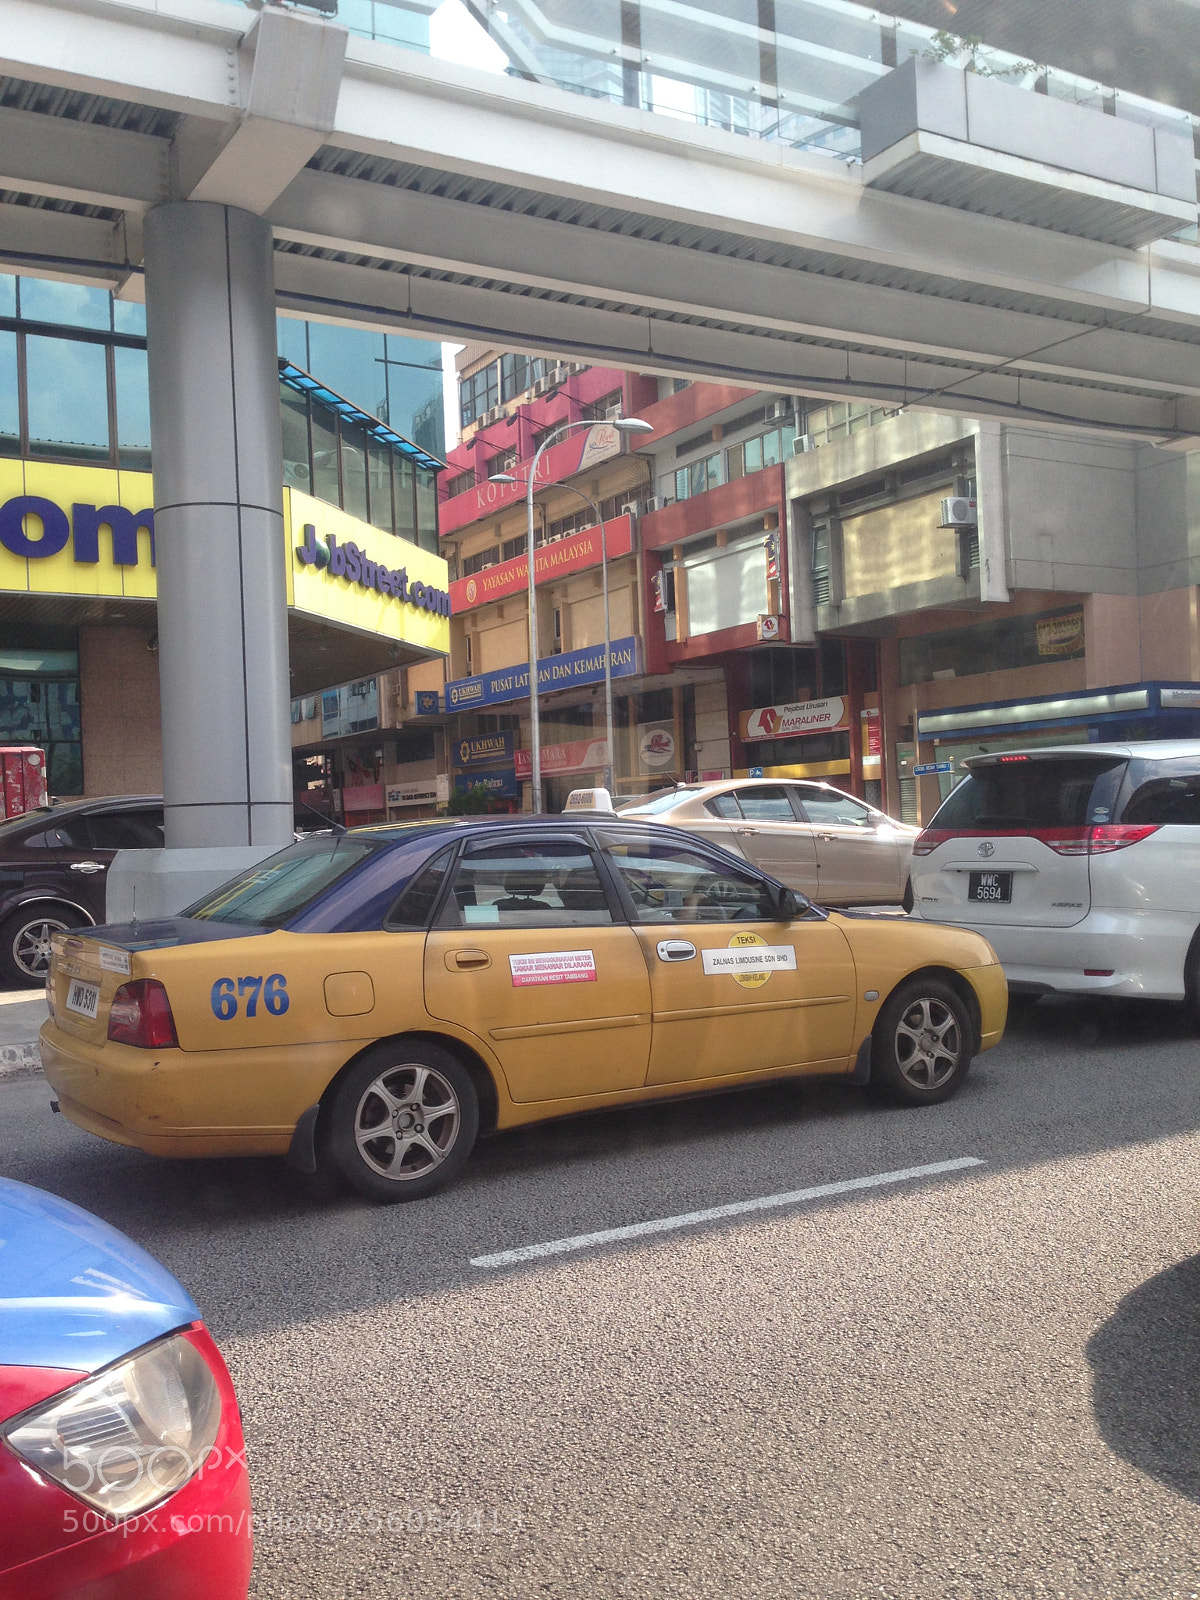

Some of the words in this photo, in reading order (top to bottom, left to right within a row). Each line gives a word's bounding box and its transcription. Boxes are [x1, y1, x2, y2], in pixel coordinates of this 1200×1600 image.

[482, 569, 515, 591] YAYASAN
[516, 556, 549, 579] WAITA
[550, 540, 593, 567] MALAYSIA
[491, 676, 513, 693] PUSAT
[552, 663, 571, 680] DAN
[574, 649, 631, 674] KEMAHRAN
[781, 713, 831, 727] MARALINER
[470, 737, 505, 752] UKHWAH
[981, 874, 999, 887] WWC
[977, 886, 1001, 899] 5694
[737, 936, 756, 944] TEKSI
[534, 963, 564, 971] MENAWAR
[564, 961, 593, 969] DILARANG
[712, 957, 734, 966] ZALNAS
[735, 955, 763, 964] LIMOUSINE
[764, 955, 775, 963] SDN
[776, 954, 788, 962] BHD
[521, 975, 548, 983] DAPATKAN
[211, 973, 290, 1020] 676
